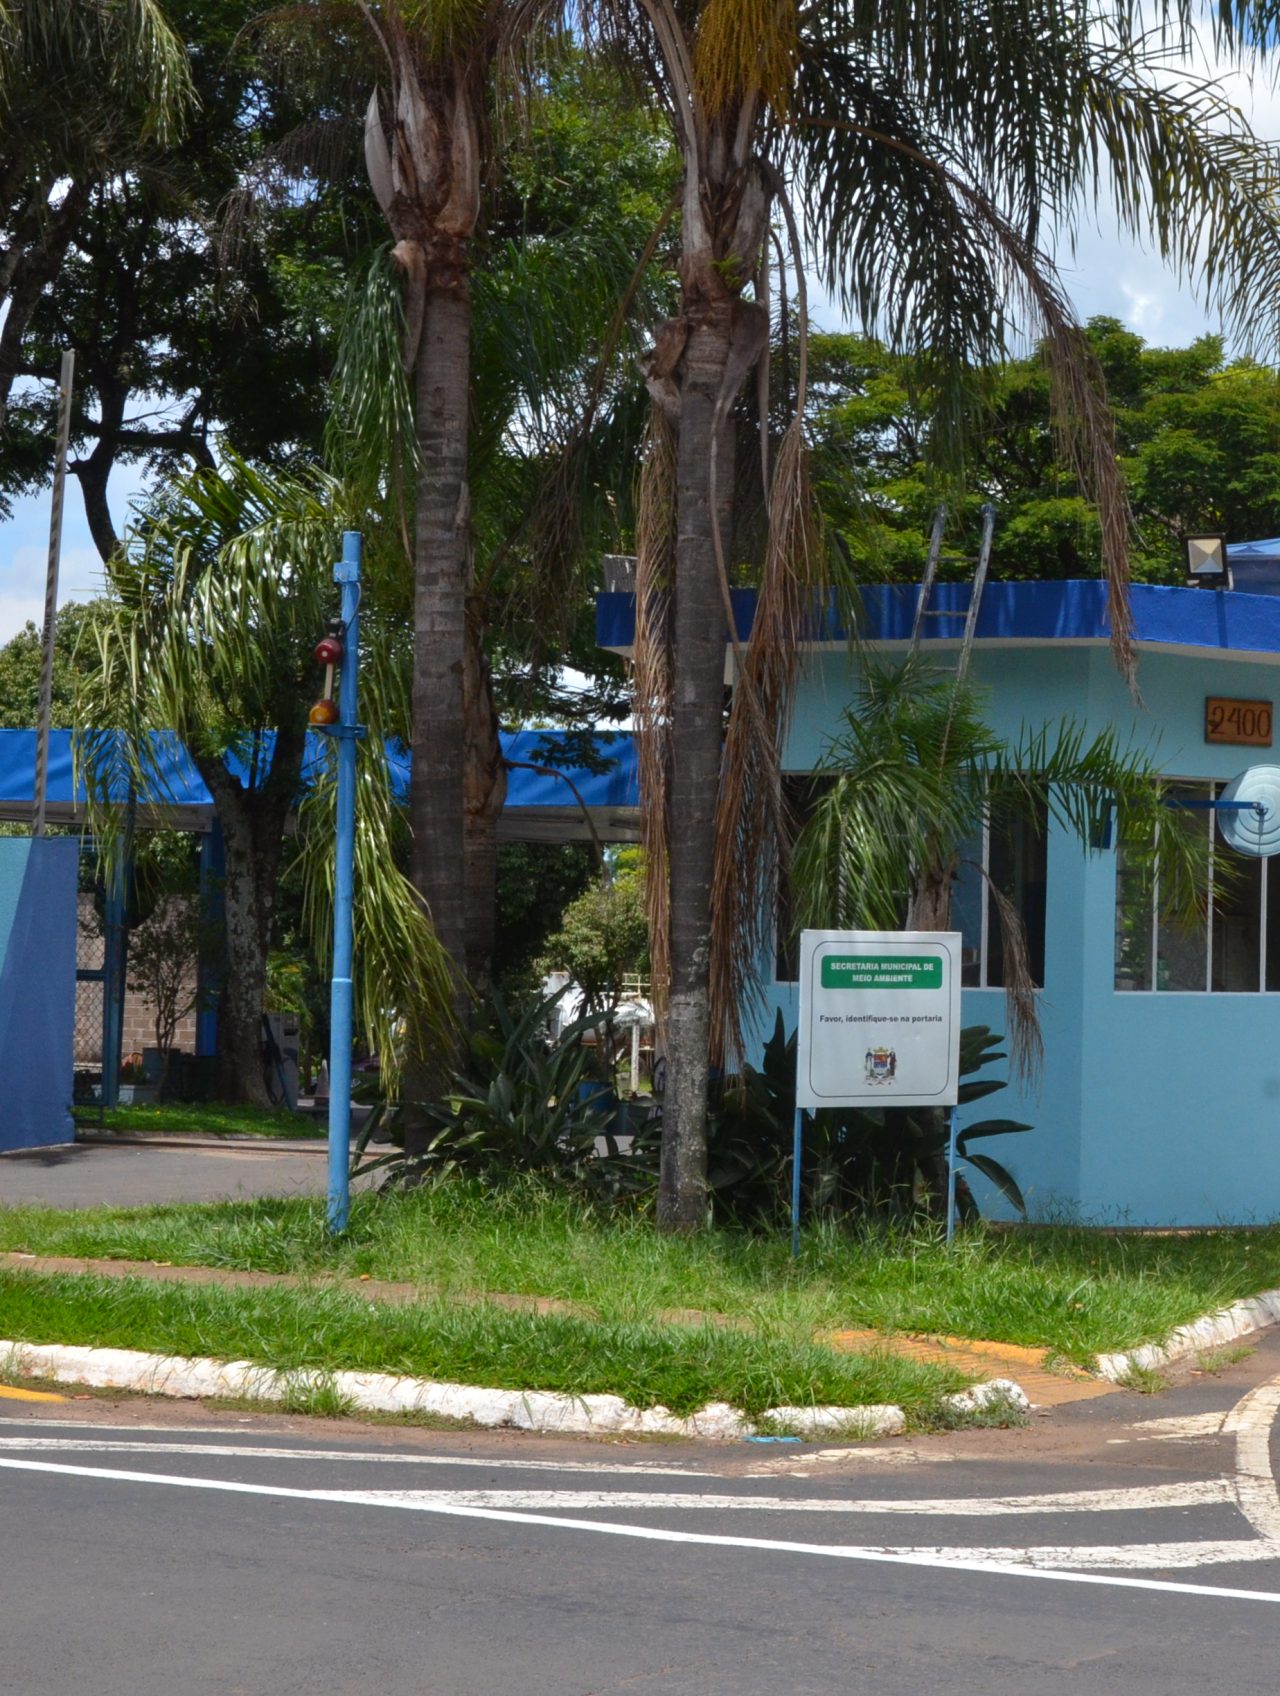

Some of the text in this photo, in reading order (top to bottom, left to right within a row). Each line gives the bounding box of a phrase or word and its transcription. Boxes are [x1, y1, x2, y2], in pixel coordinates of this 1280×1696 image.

[1208, 706, 1271, 737] 2400
[830, 962, 879, 971] SECRETARIA
[881, 963, 921, 971] MUNICIPAL
[852, 974, 872, 982] MEIO
[819, 1015, 844, 1023] Favor,
[845, 1015, 898, 1023] identifique-se
[911, 1015, 943, 1023] portaria
